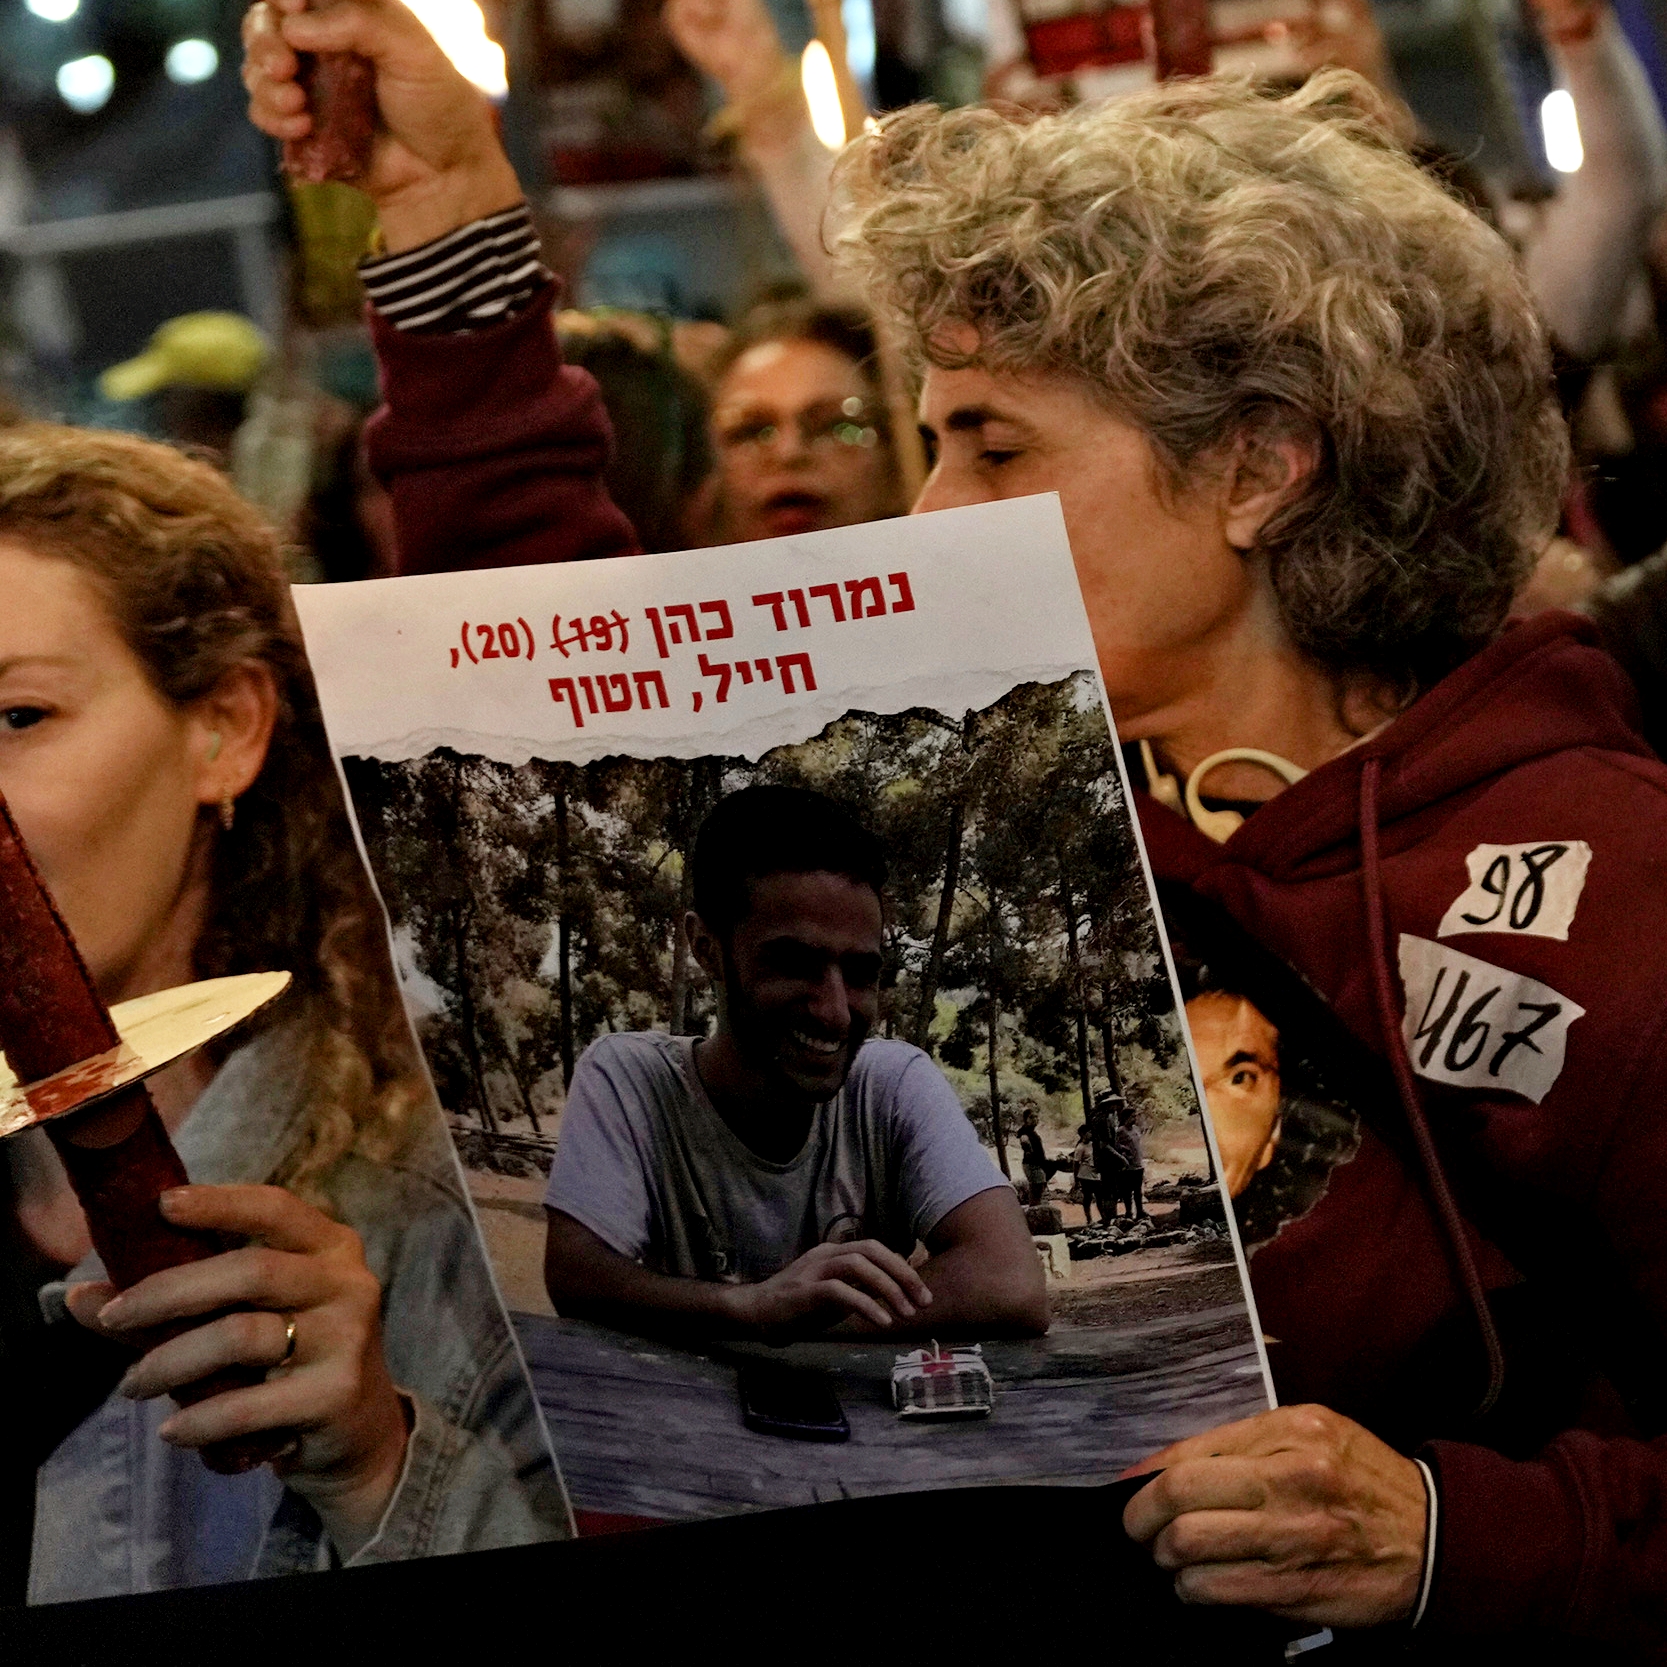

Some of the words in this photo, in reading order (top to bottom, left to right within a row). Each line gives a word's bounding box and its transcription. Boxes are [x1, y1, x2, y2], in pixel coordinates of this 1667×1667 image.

[645, 598, 733, 659] כהן
[752, 569, 916, 634] נמרוד
[448, 615, 536, 670] (20),
[548, 666, 669, 729] חטוף
[690, 651, 818, 715] חייל,
[1461, 844, 1570, 930] 98
[1413, 966, 1563, 1077] 467
